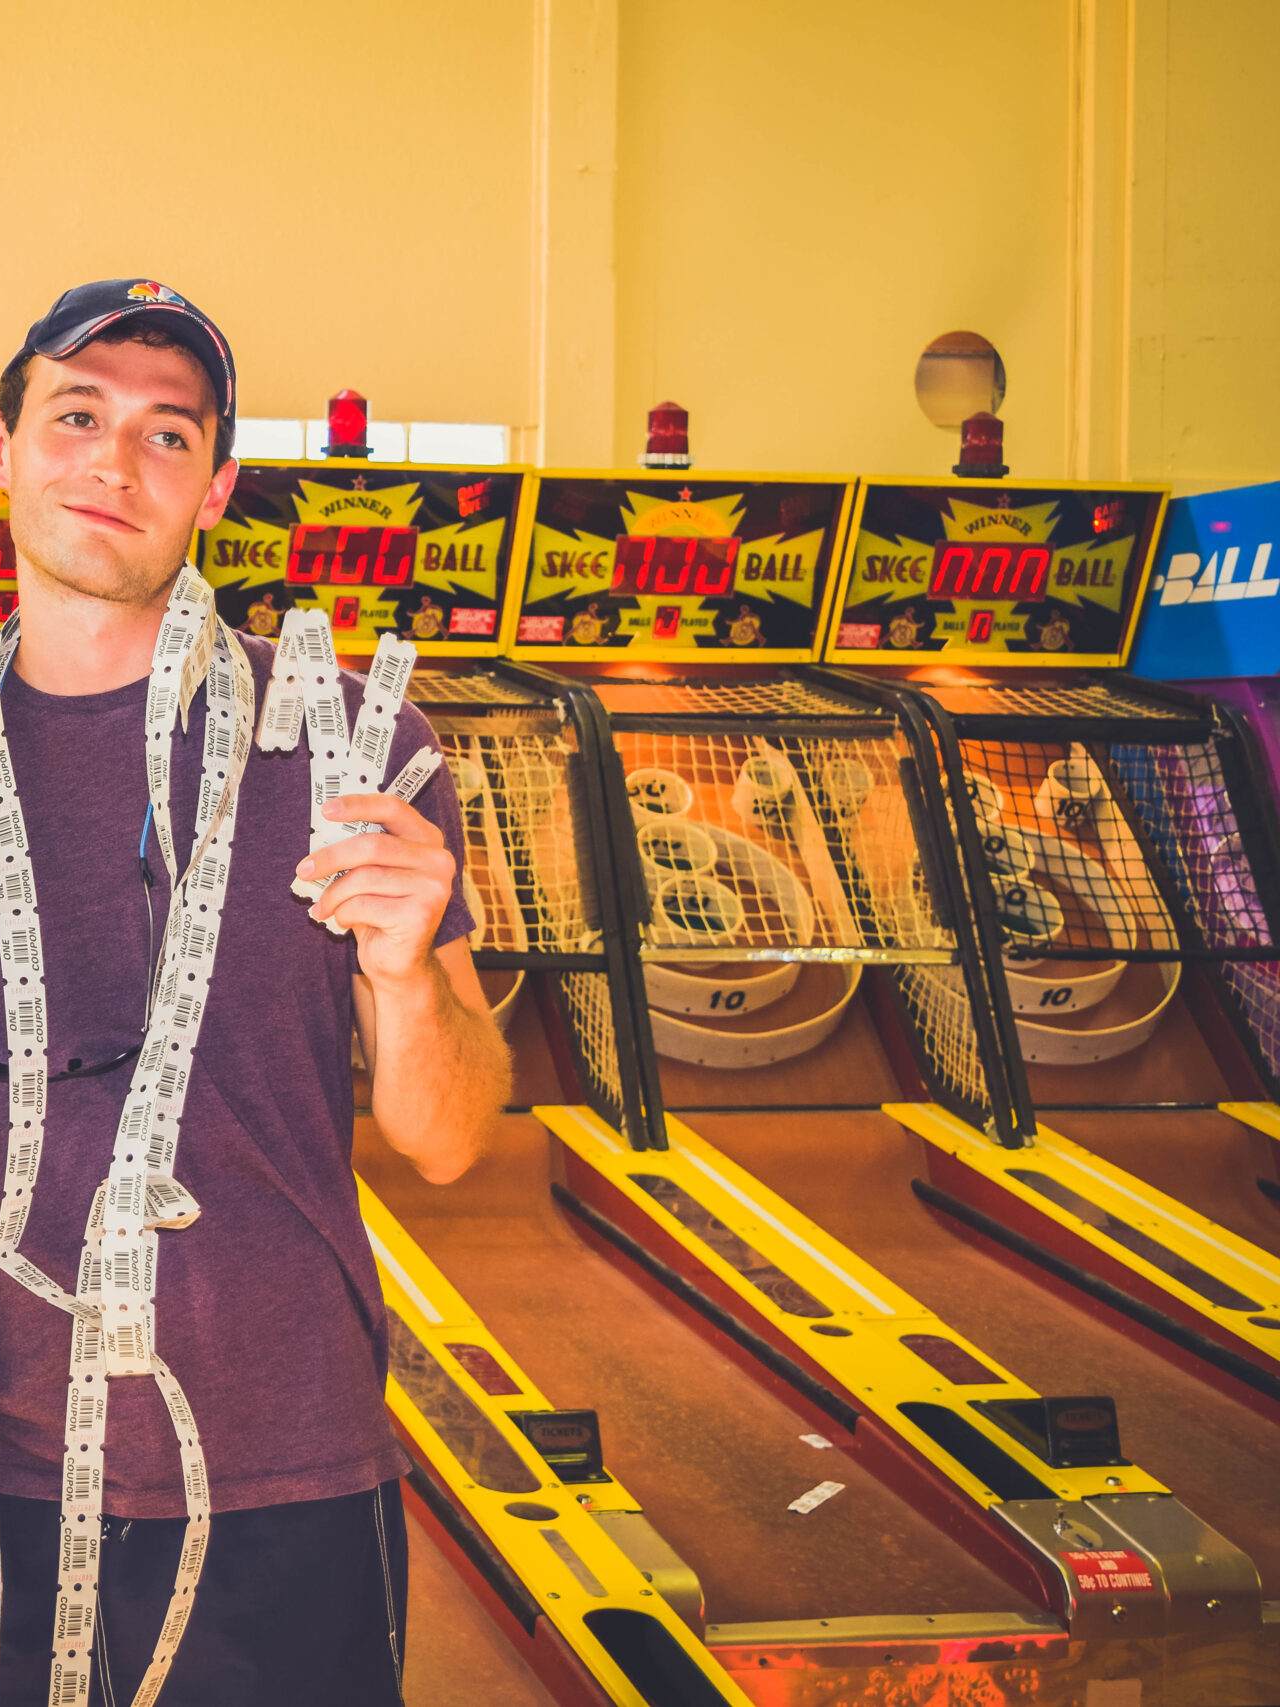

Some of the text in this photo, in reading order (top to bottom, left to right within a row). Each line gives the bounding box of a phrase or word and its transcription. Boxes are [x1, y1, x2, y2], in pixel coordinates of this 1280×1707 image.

[320, 497, 391, 520] WINNER
[647, 508, 717, 530] WINNER
[964, 514, 1033, 537] WINNER
[214, 539, 282, 568] SKEE
[423, 543, 487, 572] BALL
[542, 551, 608, 578] SKEE
[744, 553, 807, 581] BALL
[862, 555, 927, 584] SKEE
[1056, 559, 1116, 587] BALL
[174, 576, 189, 602] COUPON
[359, 609, 389, 618] PLAYED
[158, 623, 171, 658] COUPON
[183, 634, 194, 650] ONE
[320, 625, 333, 666] COUPON
[392, 657, 410, 699] COUPON
[289, 696, 304, 742] COUPON
[333, 696, 345, 739] COUPON
[207, 718, 217, 758] COUPON
[375, 728, 390, 769] COUPON
[0, 750, 12, 788] COUPON
[395, 768, 411, 787] ONE
[200, 780, 211, 822] COUPON
[12, 810, 24, 848] COUPON
[22, 869, 33, 904] COUPON
[217, 864, 226, 885] ONE
[2, 939, 11, 960] ONE
[32, 927, 40, 971] COUPON
[192, 1001, 202, 1023] ONE
[709, 990, 745, 1011] 10
[1039, 987, 1073, 1007] 10
[9, 1009, 17, 1031] ONE
[155, 1035, 168, 1072] COUPON
[176, 1071, 186, 1093] ONE
[28, 1140, 39, 1182] COUPON
[91, 1191, 106, 1228] COUPON
[133, 1173, 146, 1216] COUPON
[172, 1186, 187, 1198] ONE
[13, 1205, 28, 1245] COUPON
[22, 1261, 57, 1289] COUPON
[80, 1252, 91, 1294] COUPON
[144, 1246, 154, 1292] COUPON
[75, 1319, 84, 1363] COUPON
[135, 1322, 144, 1359] COUPON
[177, 1389, 195, 1433] COUPON
[63, 1527, 72, 1572] COUPON
[193, 1534, 206, 1580] COUPON
[1098, 1560, 1118, 1570] AND
[1095, 1575, 1109, 1587] TO
[1109, 1573, 1152, 1587] CONTINUE
[57, 1596, 67, 1639] COUPON
[84, 1607, 93, 1628] ONE
[172, 1605, 190, 1649] COUPON
